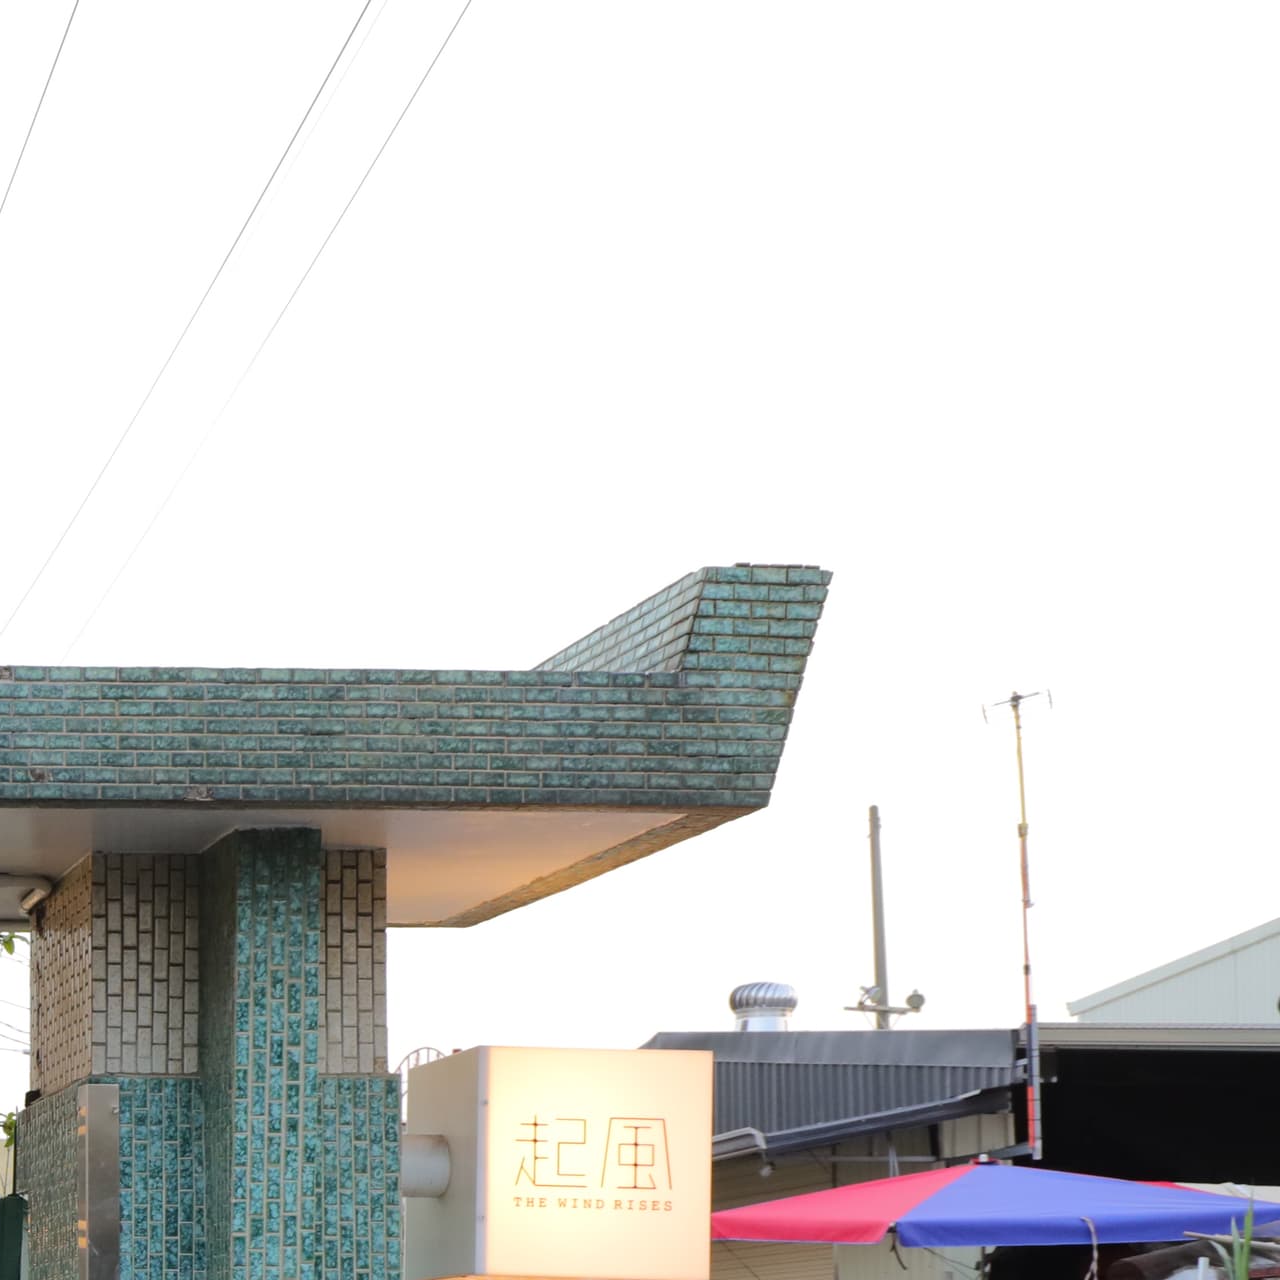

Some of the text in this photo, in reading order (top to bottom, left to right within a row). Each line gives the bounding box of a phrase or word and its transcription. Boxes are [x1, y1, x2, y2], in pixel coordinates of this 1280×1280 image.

[514, 1115, 672, 1190] 起風
[513, 1196, 673, 1212] THE WIND RISES
